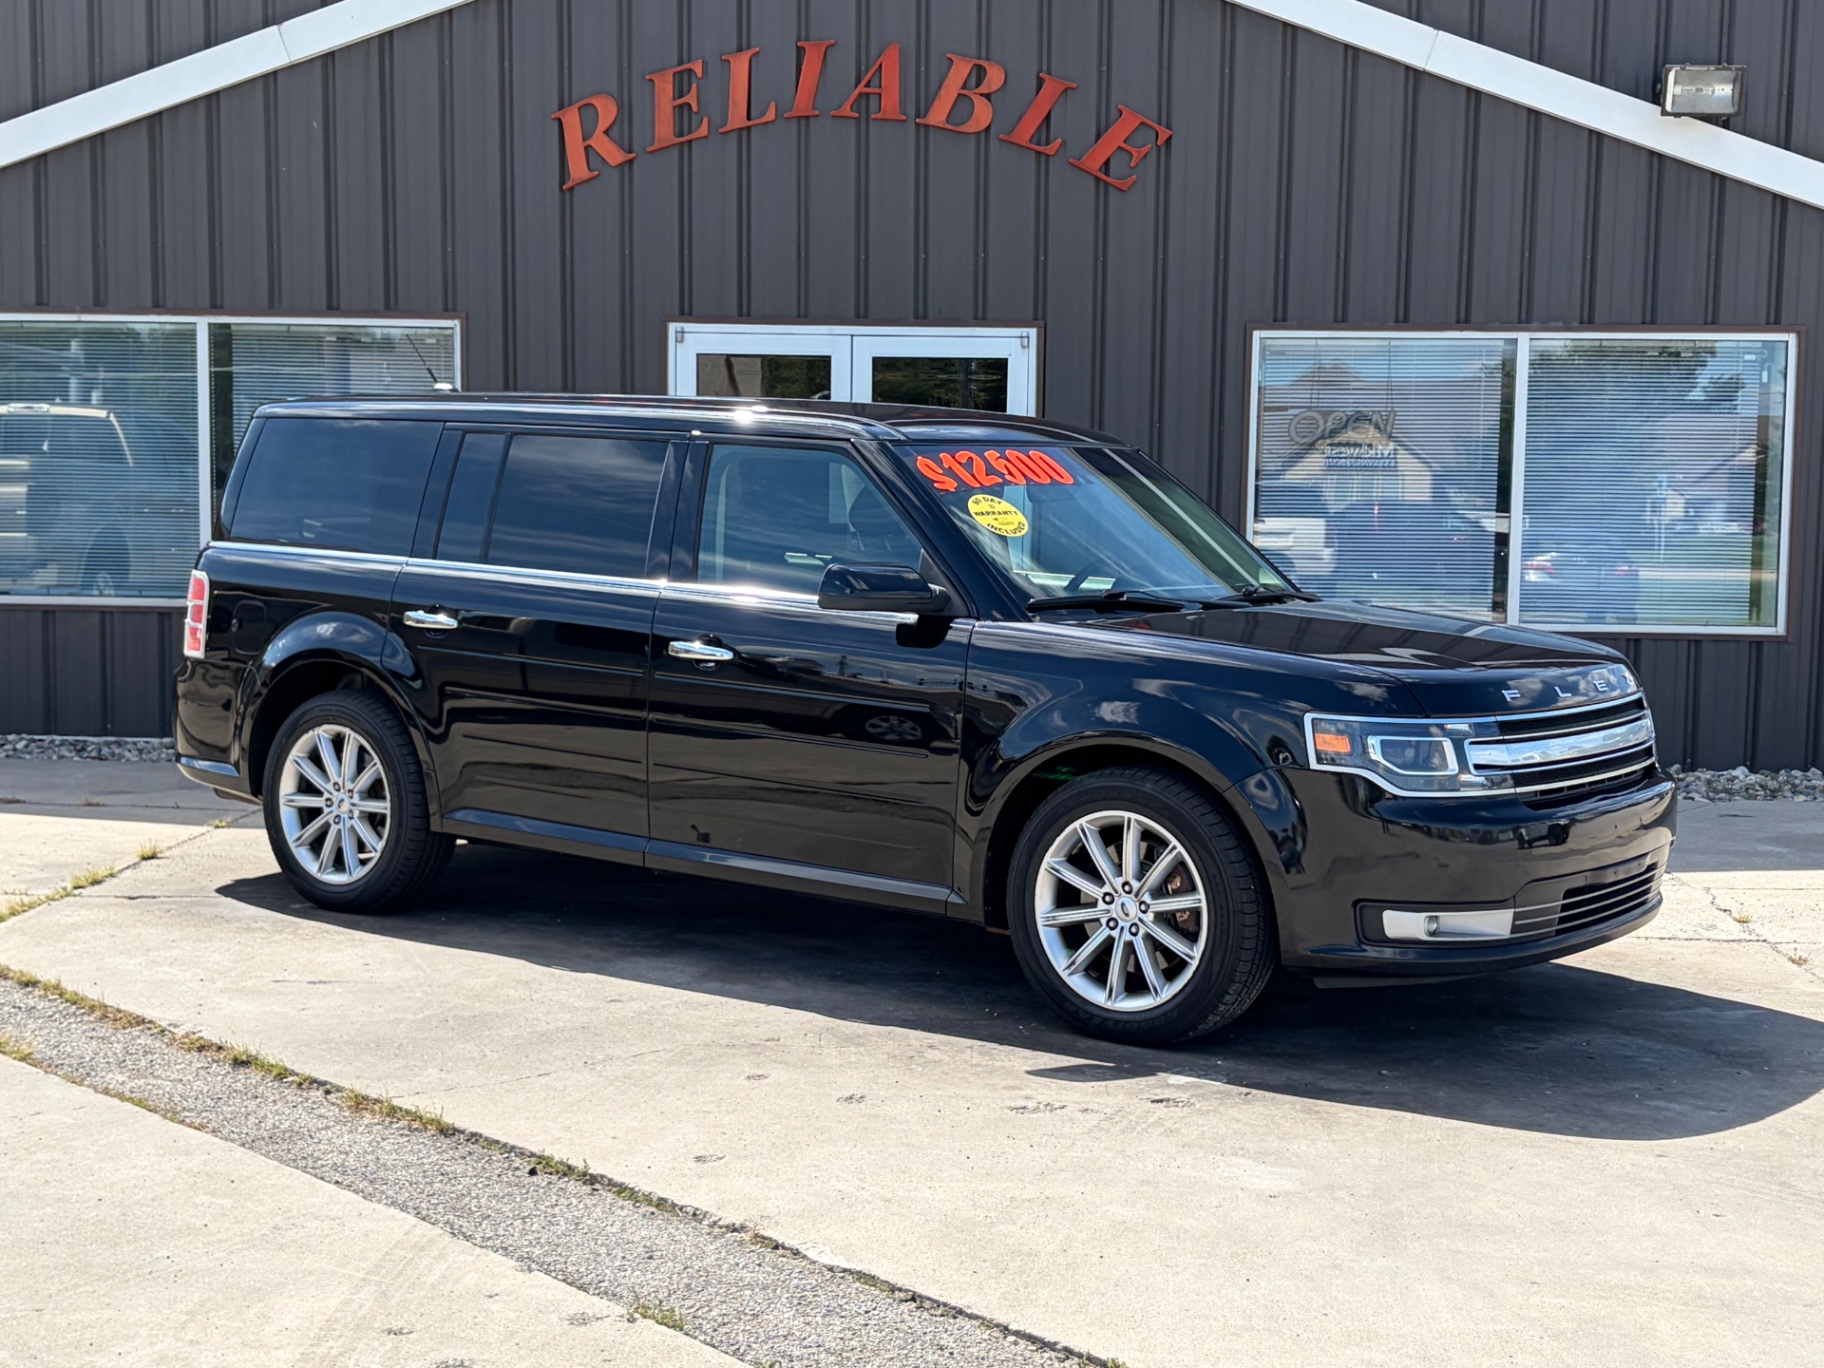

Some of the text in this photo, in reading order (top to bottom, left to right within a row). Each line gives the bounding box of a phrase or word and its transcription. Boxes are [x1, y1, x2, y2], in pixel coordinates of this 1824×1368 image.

[551, 39, 1173, 191] RELIABLE
[1289, 409, 1396, 446] OPEN
[917, 450, 1074, 492] $12500
[982, 496, 1002, 505] DAY
